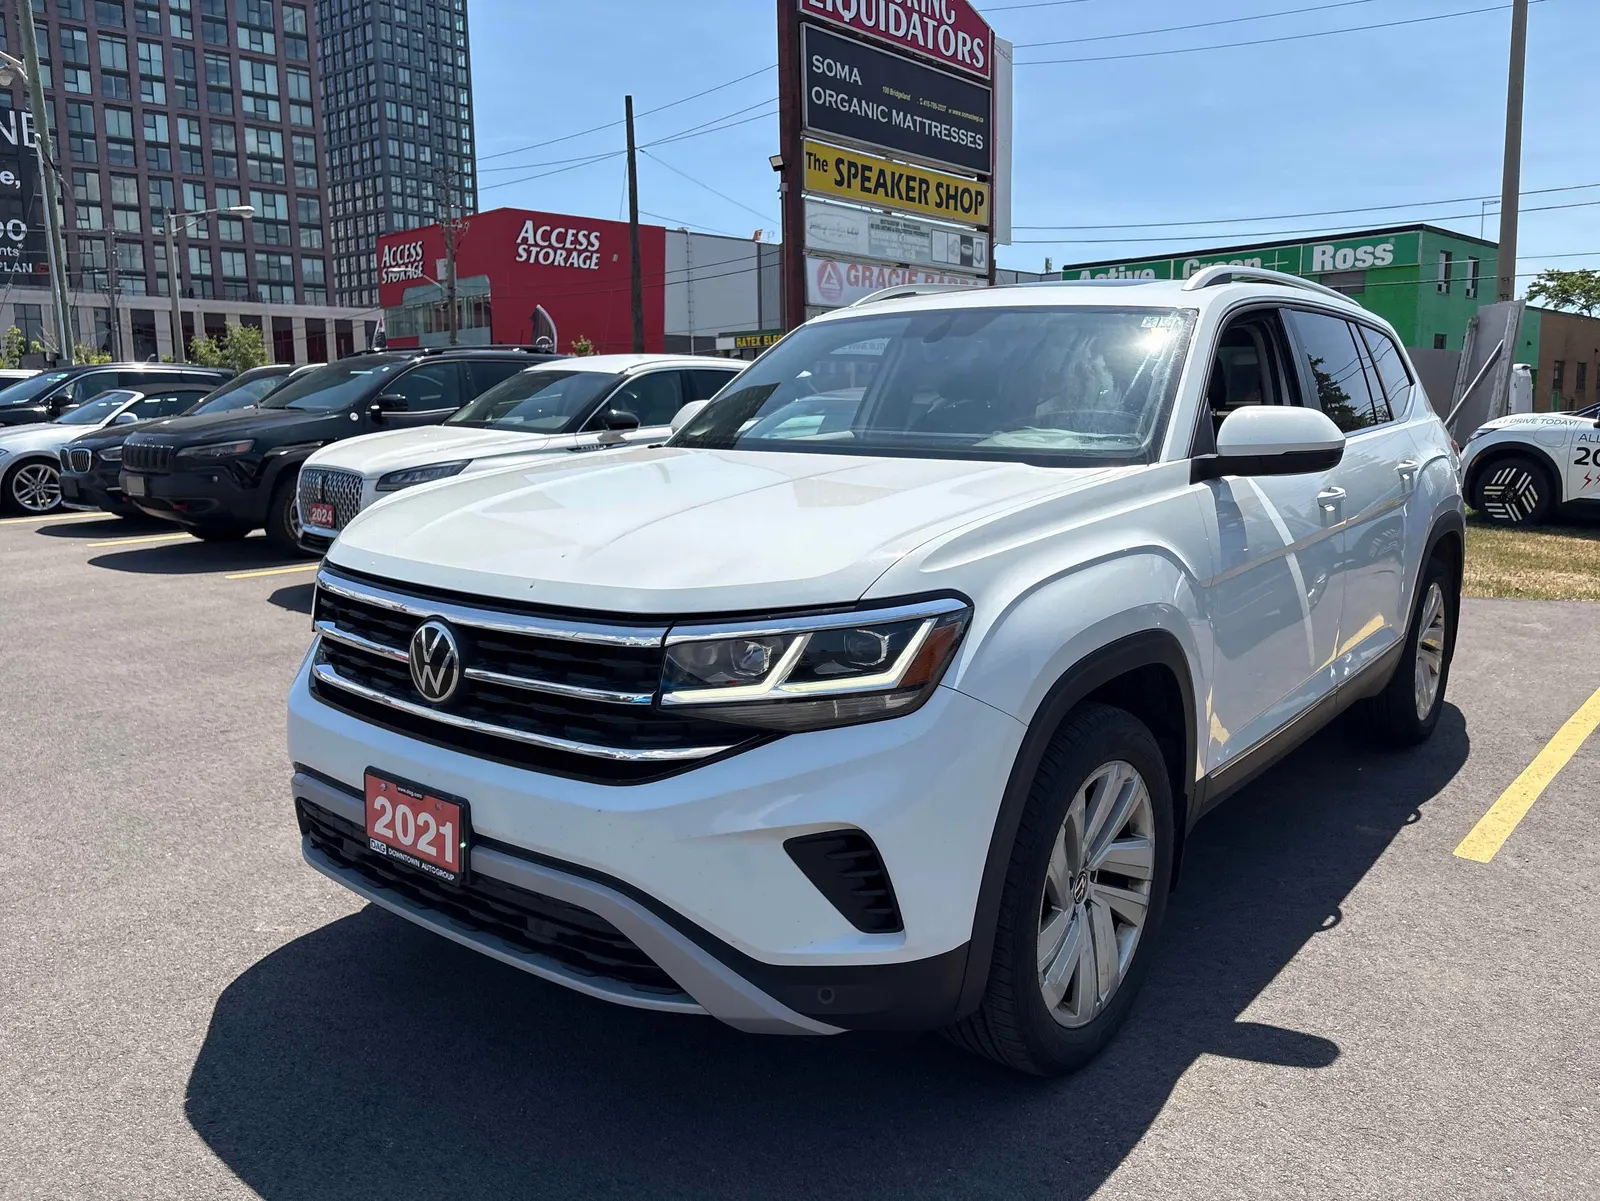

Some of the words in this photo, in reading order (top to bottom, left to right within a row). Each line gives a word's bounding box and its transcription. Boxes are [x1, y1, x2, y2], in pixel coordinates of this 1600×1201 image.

[809, 0, 984, 69] QUIDATORS
[812, 54, 863, 86] SOMA
[811, 86, 889, 123] ORGANIC
[892, 109, 984, 150] MATTRESSES
[805, 151, 828, 173] The
[834, 157, 930, 206] SPEAKER
[935, 181, 985, 216] SHOP
[516, 219, 601, 251] ACCESS
[381, 240, 424, 268] ACCESS
[515, 244, 601, 270] STORAGE
[845, 263, 919, 290] GRACIE
[1541, 418, 1578, 427] TODAY!
[311, 507, 333, 523] 2024
[373, 795, 453, 863] 2021
[387, 847, 420, 868] DOWNTOWN
[421, 862, 455, 881] AUTOGROUP
